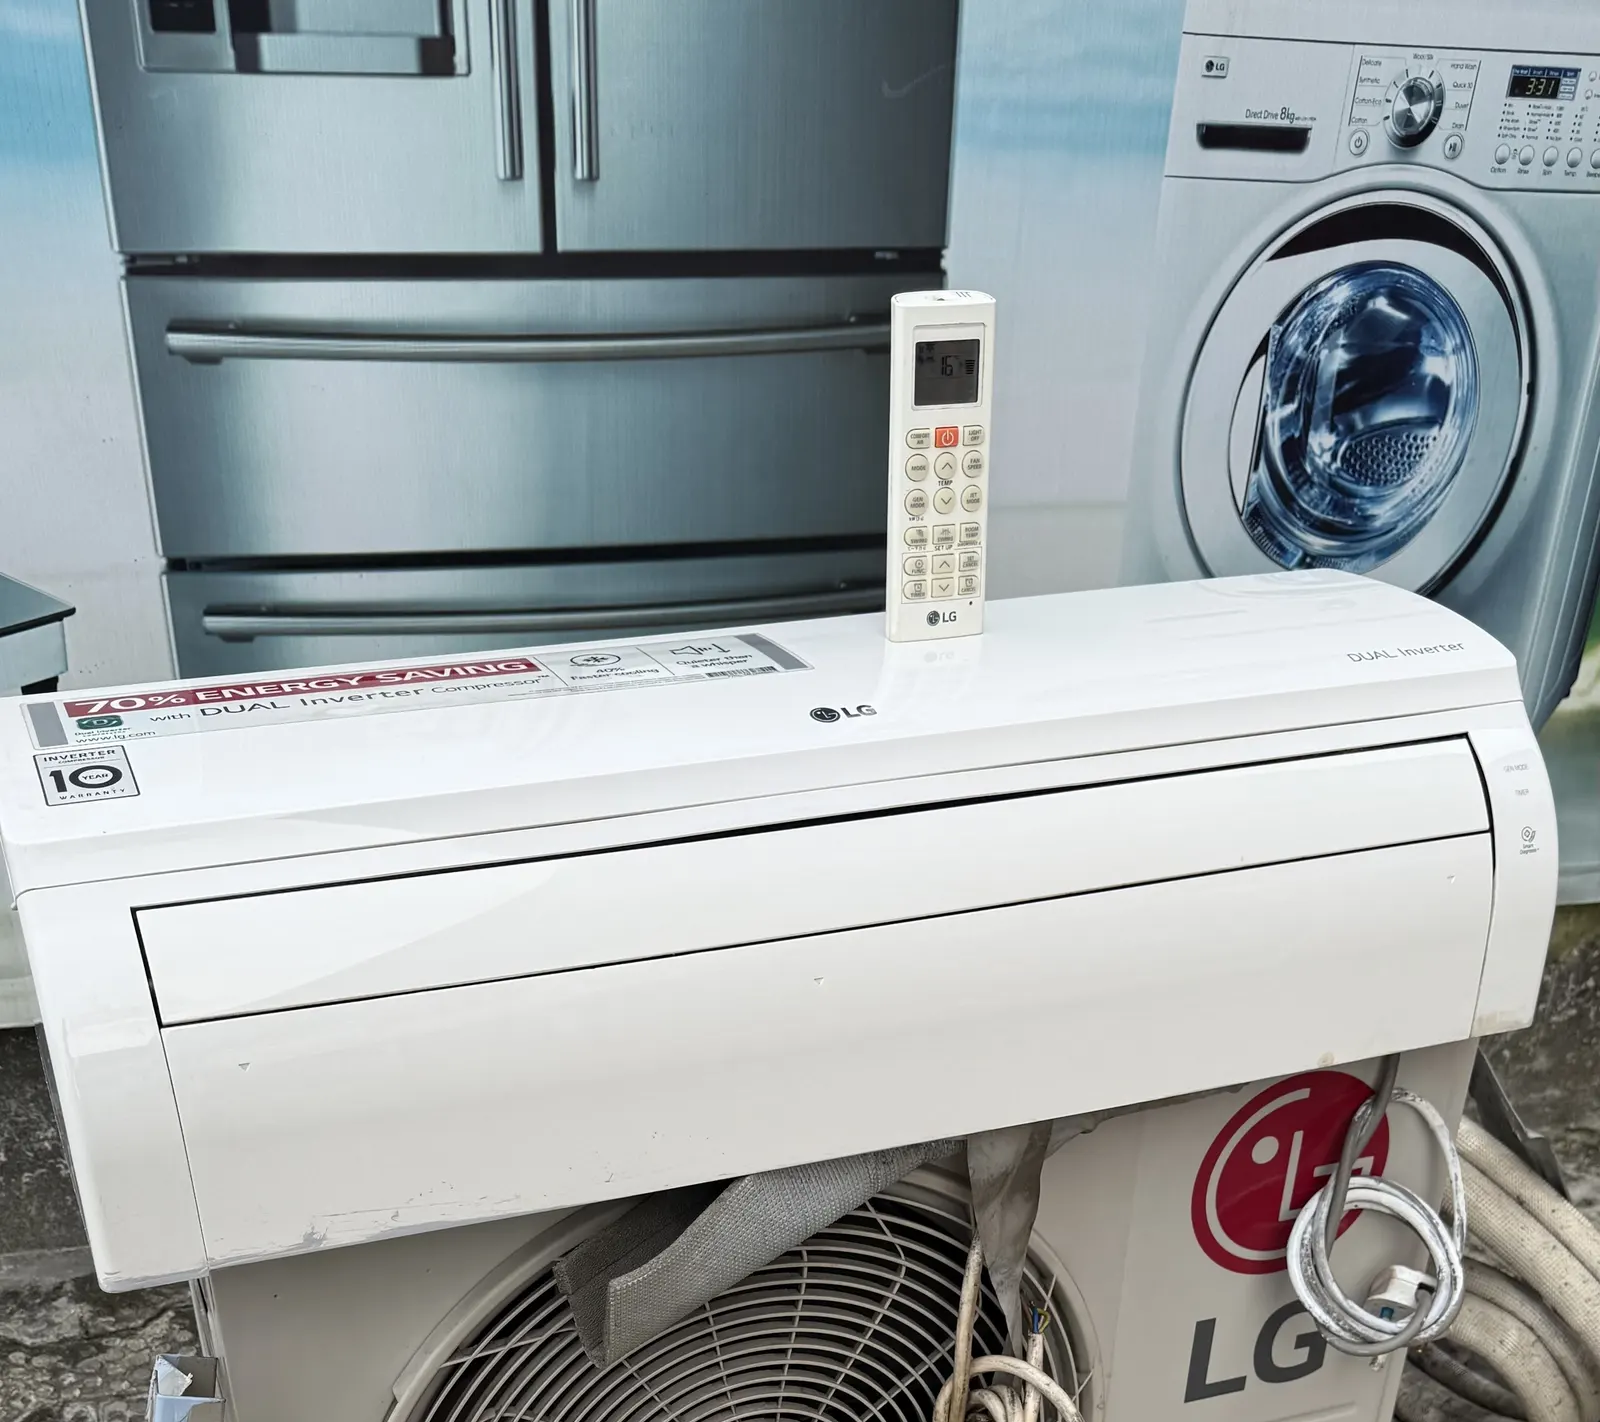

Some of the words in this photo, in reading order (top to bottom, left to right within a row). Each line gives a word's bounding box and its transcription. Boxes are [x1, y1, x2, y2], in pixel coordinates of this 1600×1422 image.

[1215, 62, 1225, 71] LG
[1526, 78, 1555, 95] 3:31
[1245, 108, 1263, 119] Direct
[942, 611, 957, 623] LG
[1347, 650, 1397, 663] DUAL
[1397, 641, 1464, 657] Inverter
[74, 694, 186, 714] 70%
[196, 676, 369, 700] ENERGY
[375, 661, 529, 684] SAVING
[150, 712, 191, 722] with
[199, 701, 290, 717] DUAL
[300, 687, 426, 707] Inverter
[840, 705, 878, 719] LG
[43, 749, 116, 763] INVERTER
[49, 765, 123, 793] 10
[59, 788, 126, 801] WARRANTY
[1183, 1300, 1328, 1404] LG
